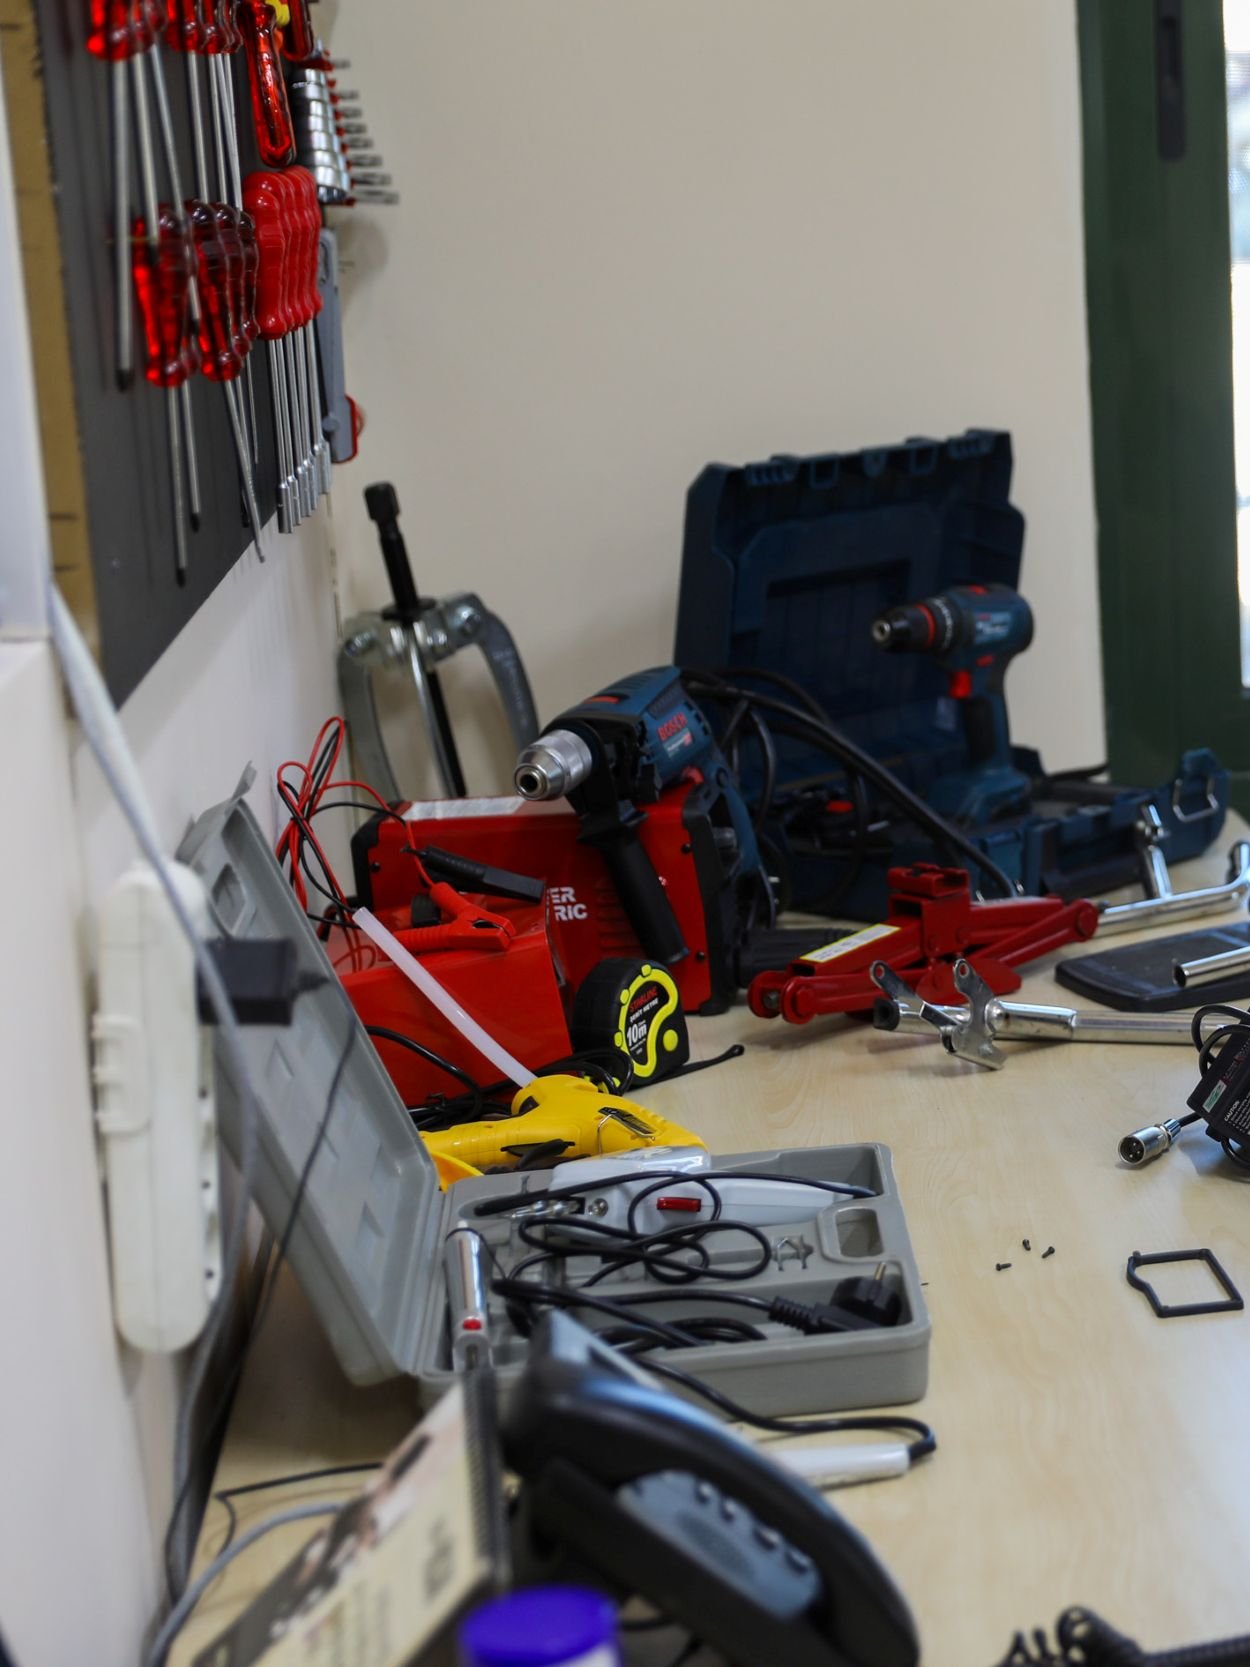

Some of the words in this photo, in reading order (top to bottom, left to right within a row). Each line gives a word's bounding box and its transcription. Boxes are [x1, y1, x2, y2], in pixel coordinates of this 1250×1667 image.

[658, 712, 687, 741] BOSCH
[550, 887, 577, 903] ER
[553, 903, 588, 921] RIC
[627, 1024, 647, 1046] 10m
